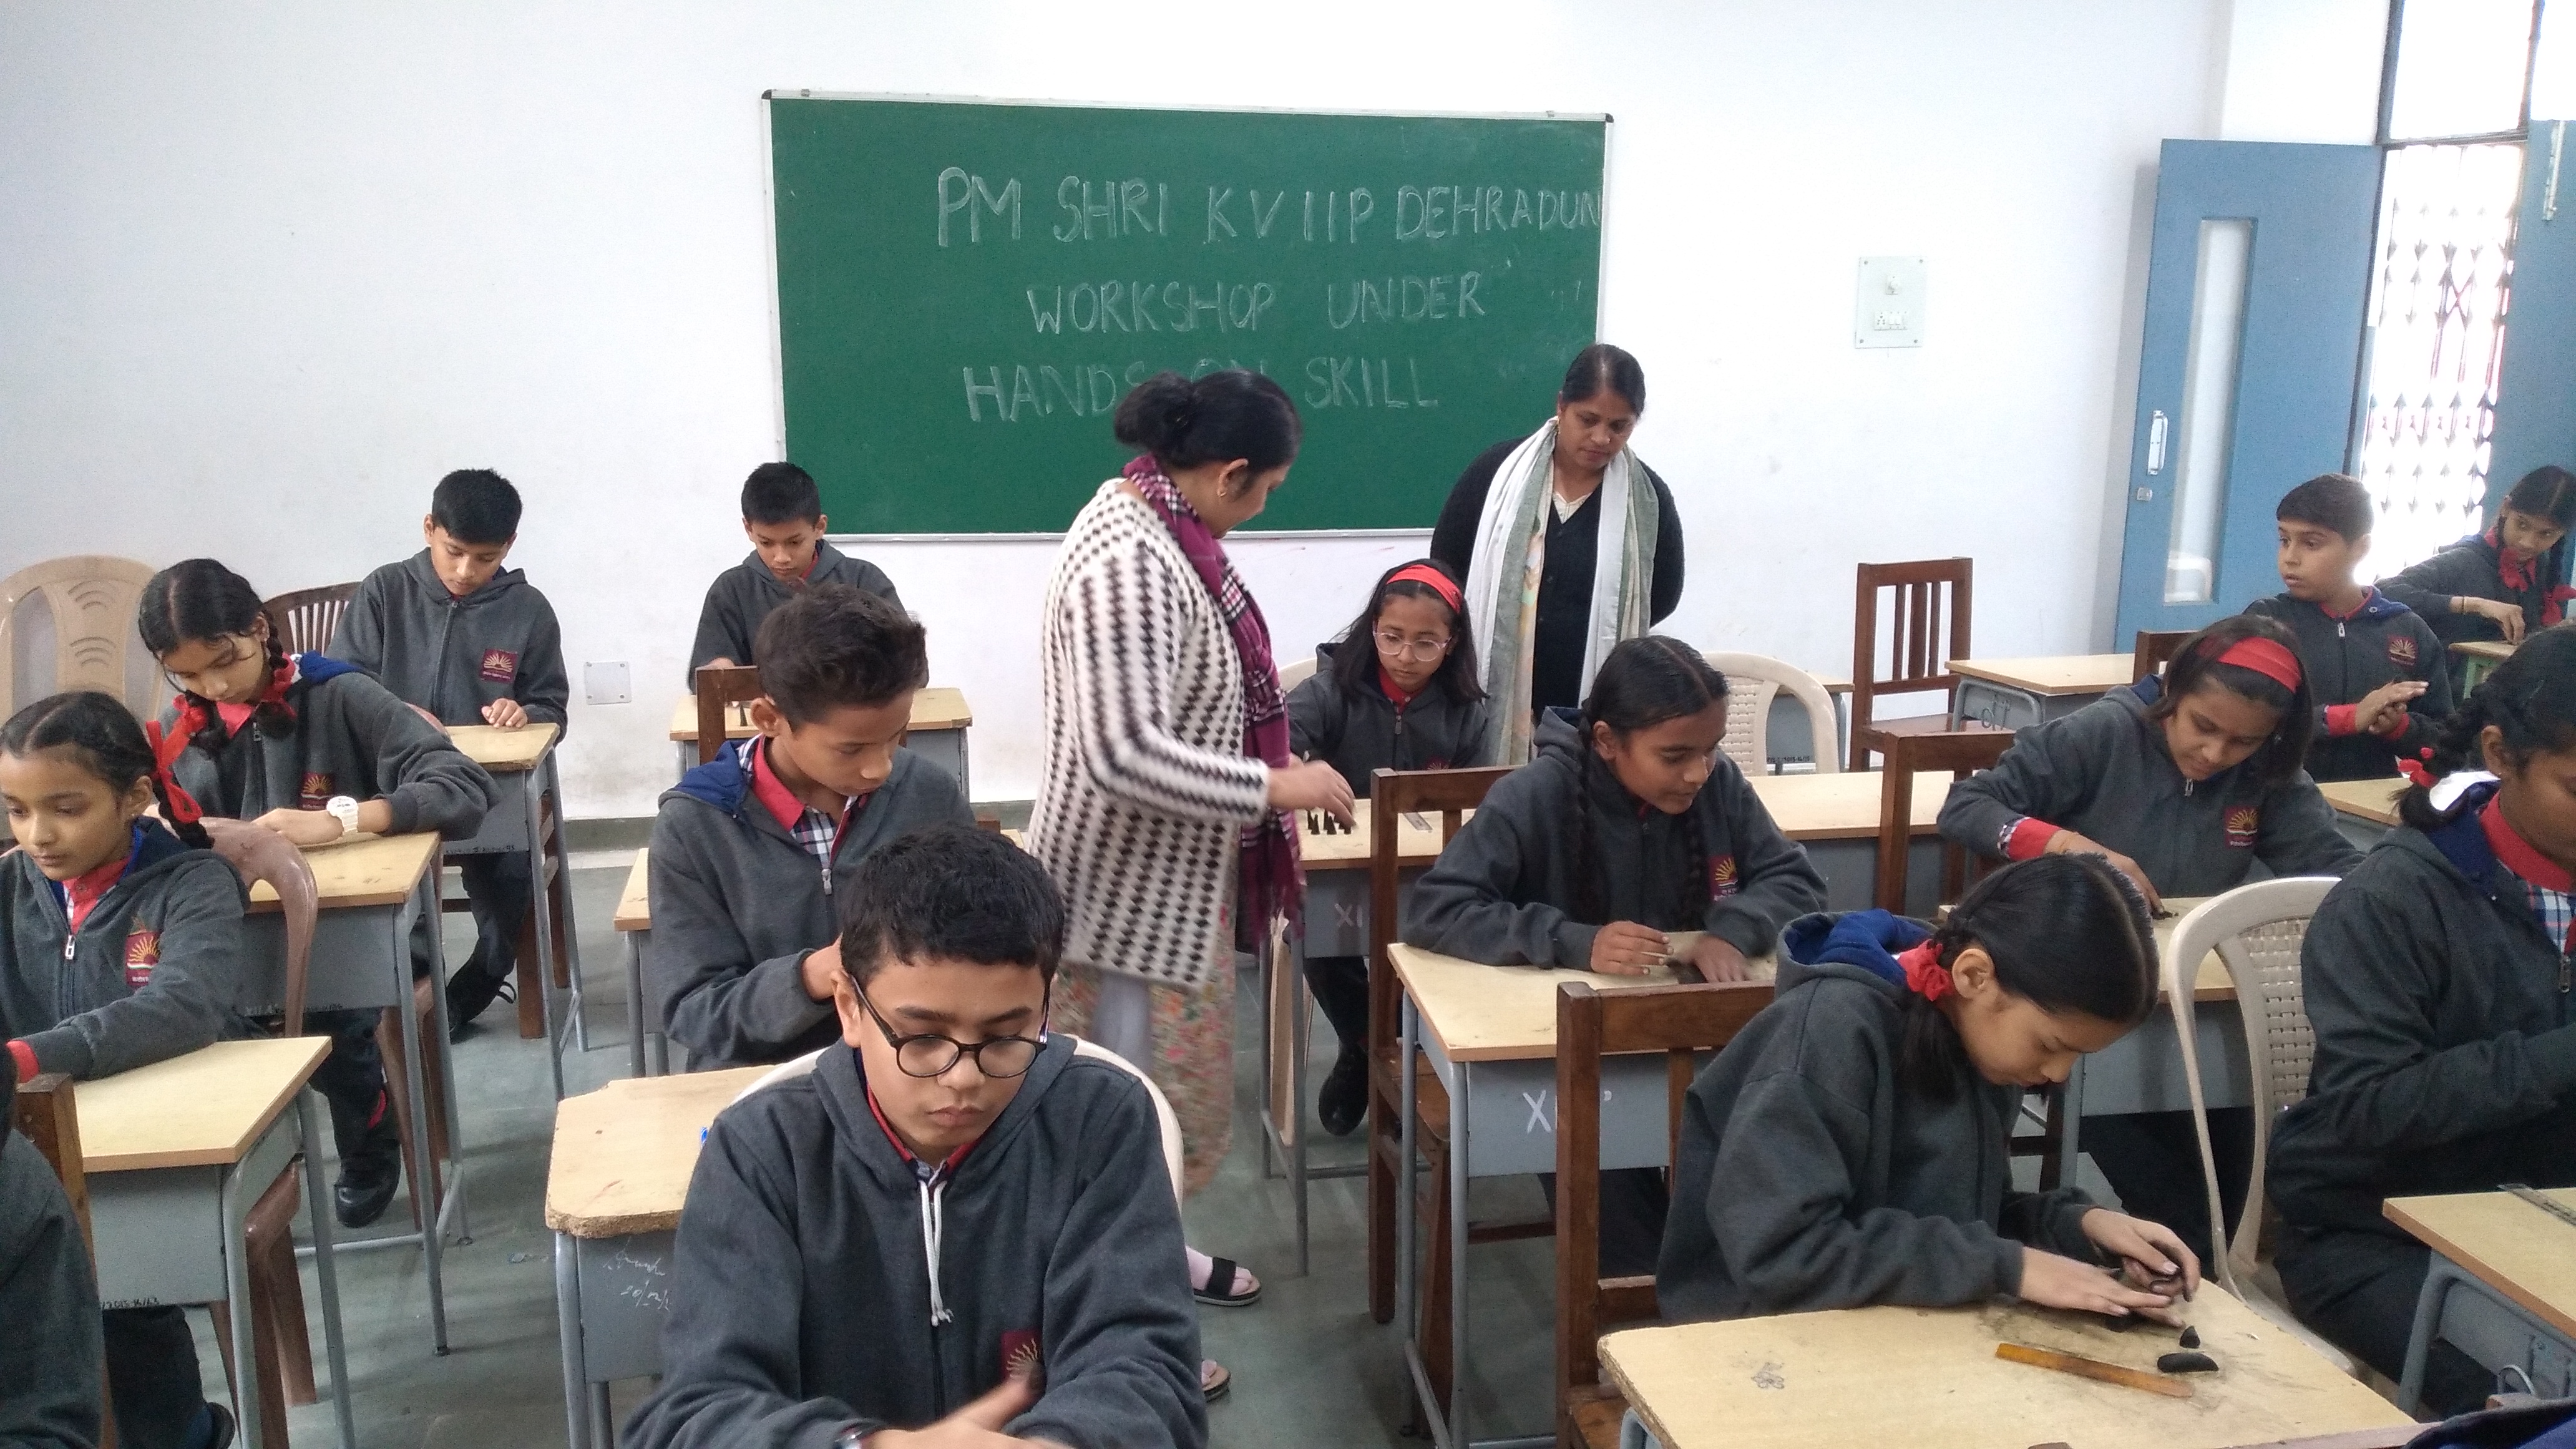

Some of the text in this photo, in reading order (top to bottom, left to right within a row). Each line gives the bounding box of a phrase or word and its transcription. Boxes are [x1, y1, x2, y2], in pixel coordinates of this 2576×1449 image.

[938, 167, 1021, 247] PM
[1053, 175, 1168, 242] SHRI
[1396, 185, 1601, 241] DEHRADUN
[1027, 270, 1486, 334] WORKSHOP UNDER
[1304, 356, 1438, 409] SKILL
